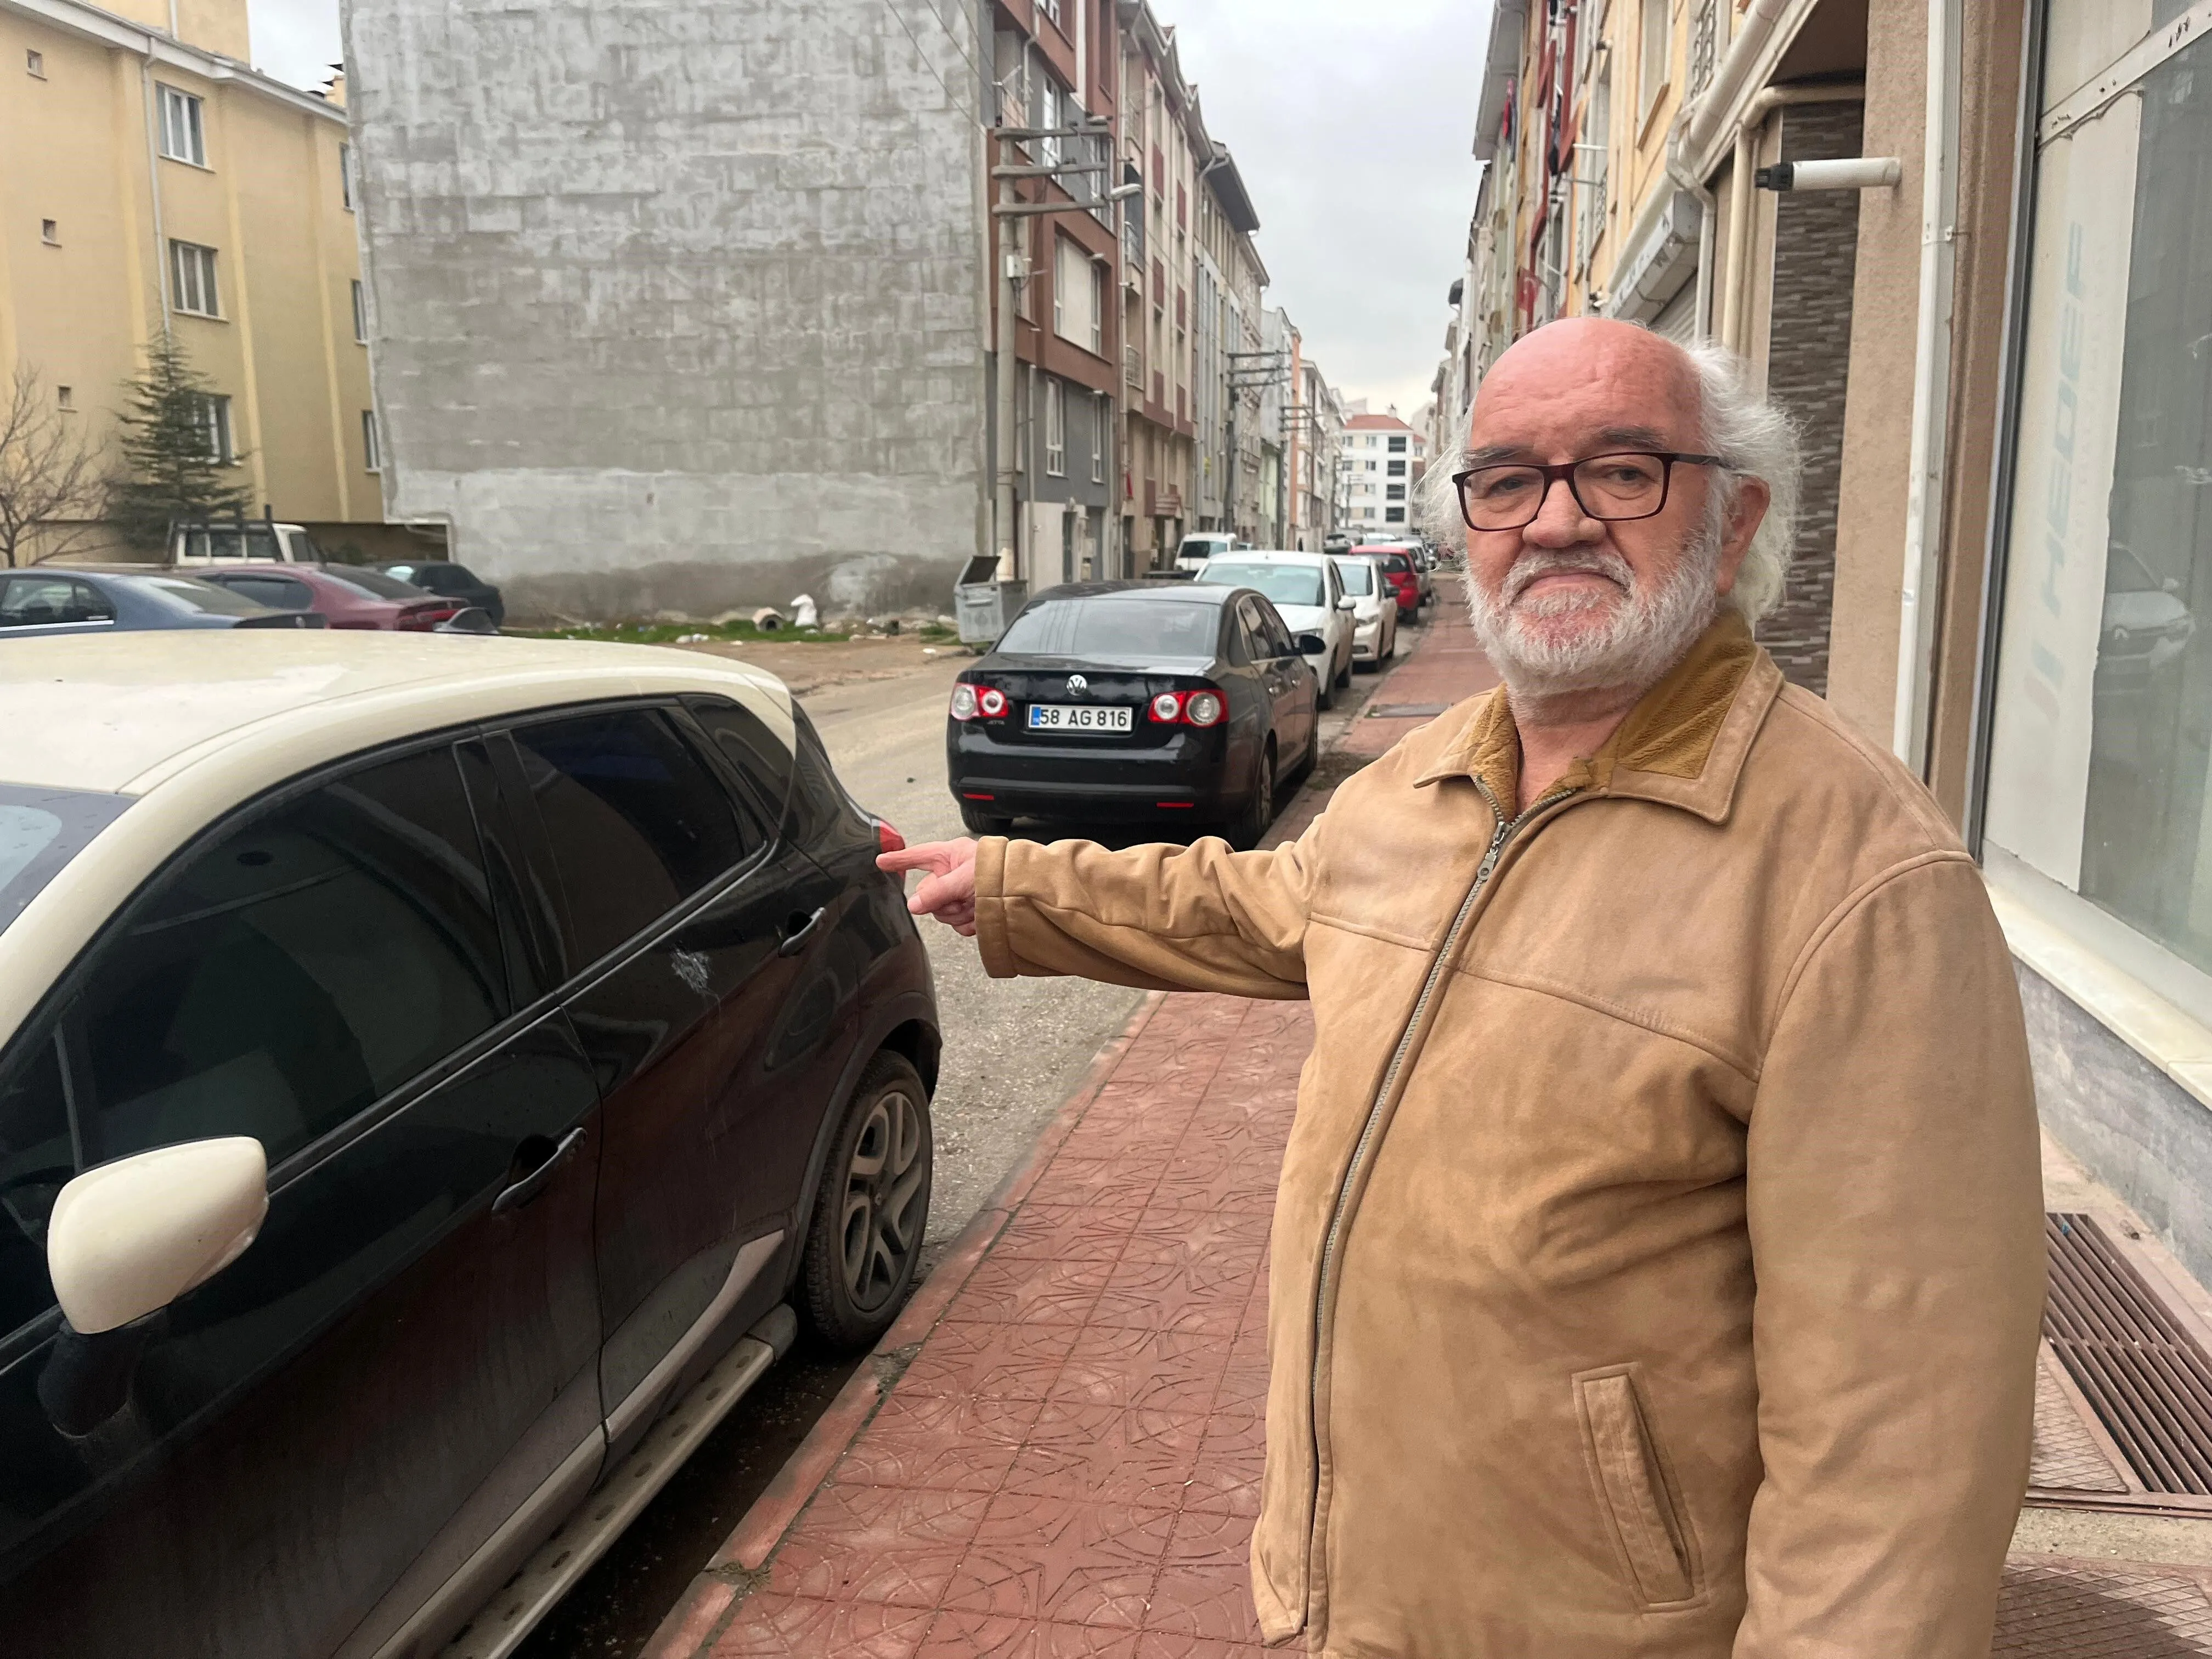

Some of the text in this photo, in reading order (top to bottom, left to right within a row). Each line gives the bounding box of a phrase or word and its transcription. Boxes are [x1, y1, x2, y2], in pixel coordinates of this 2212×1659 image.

[2040, 219, 2085, 619] HEDEF
[1041, 709, 1126, 726] 58 AG 816
